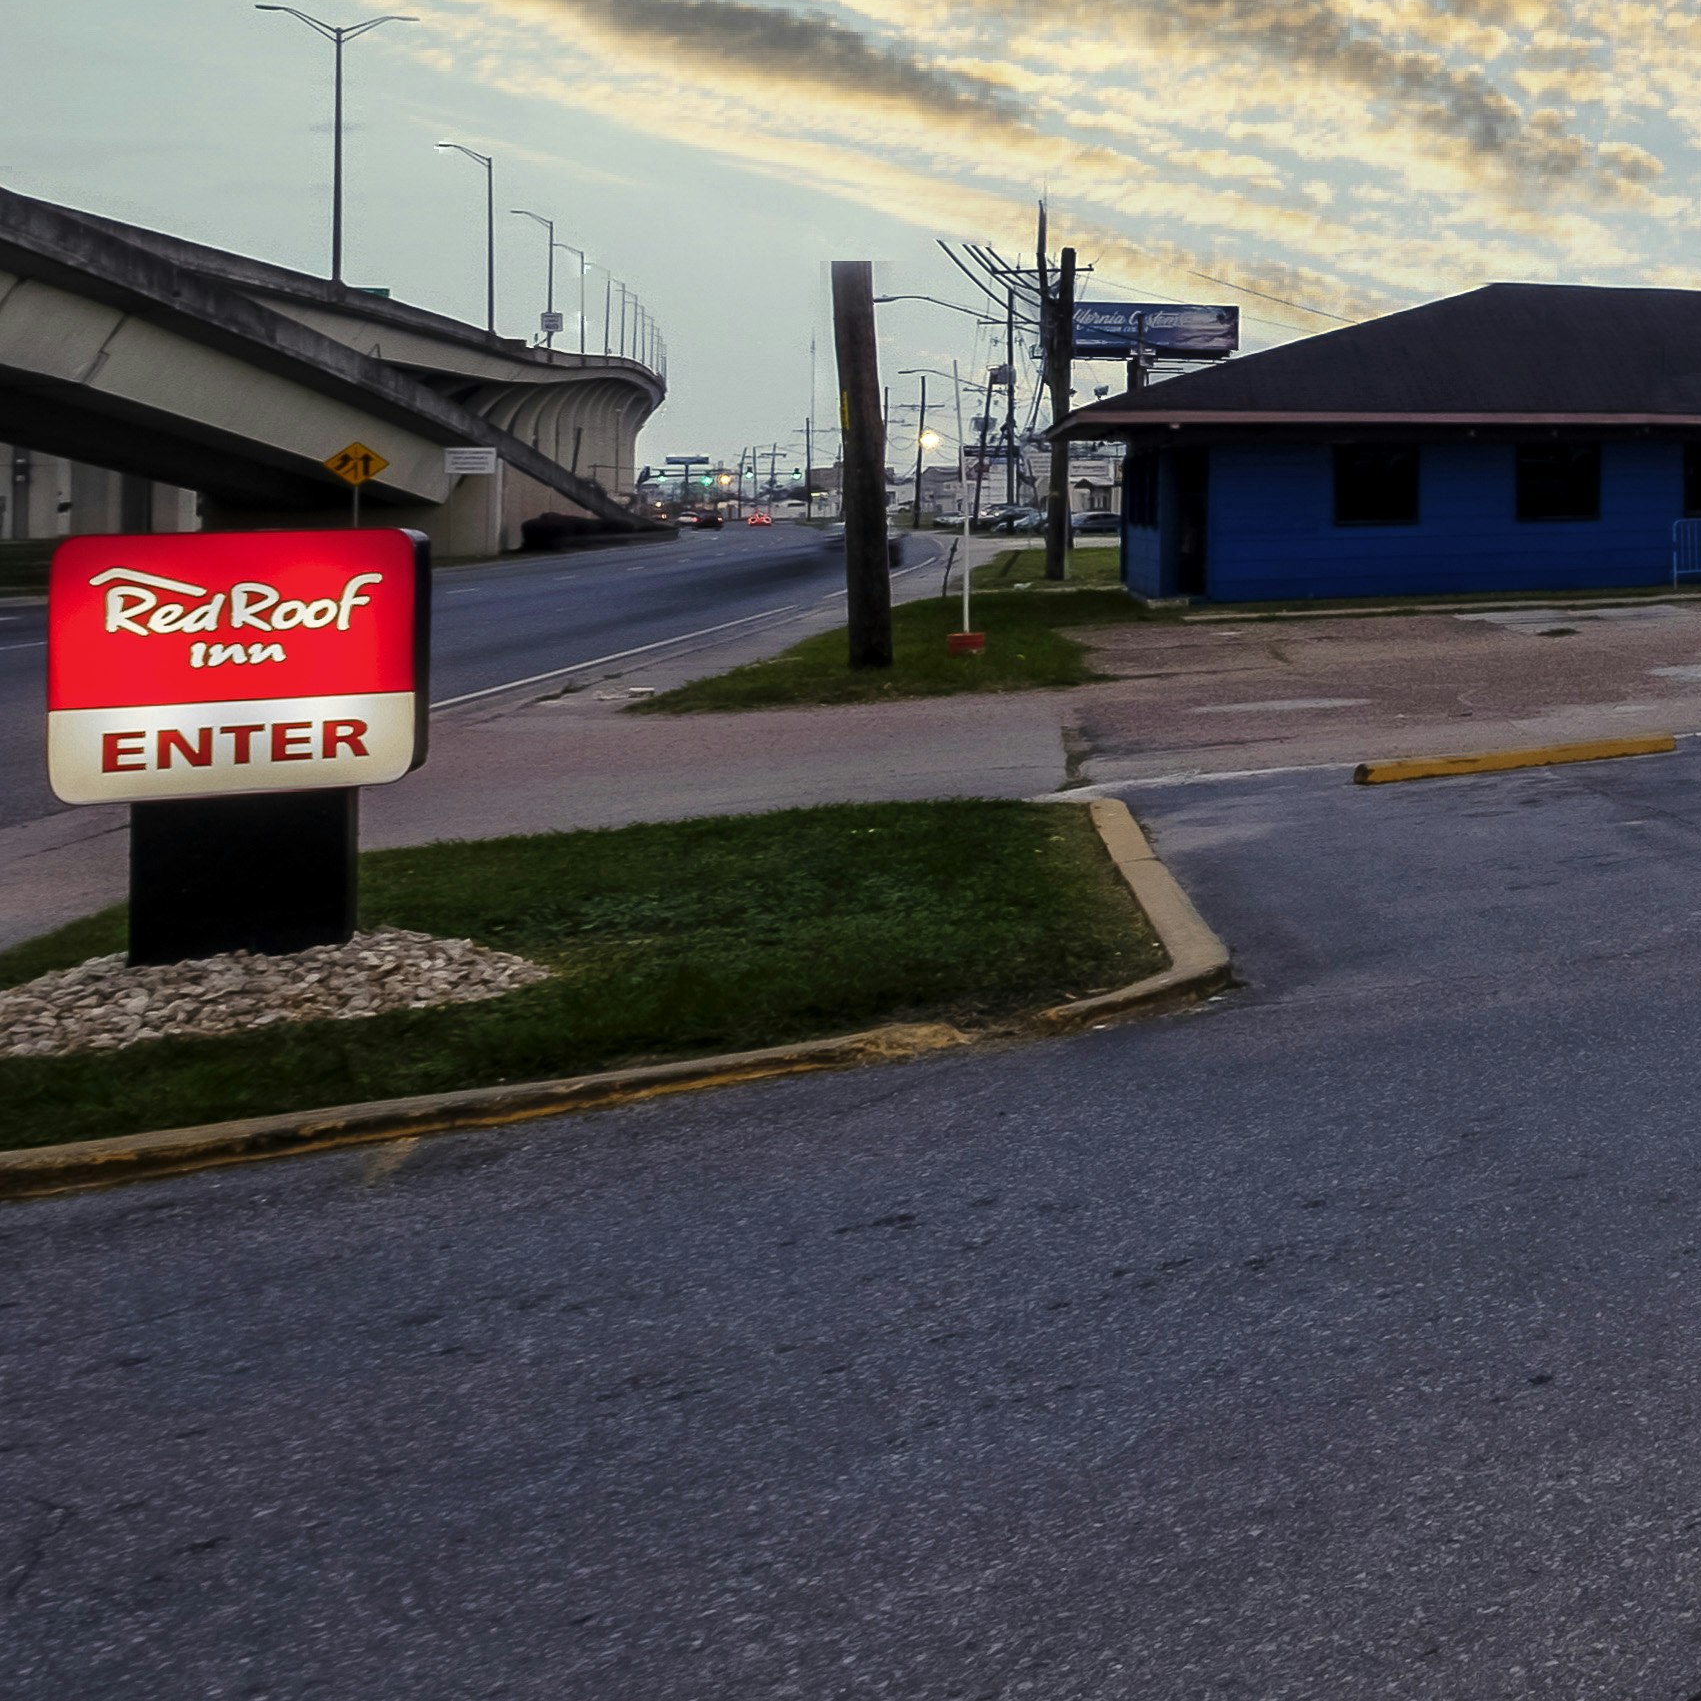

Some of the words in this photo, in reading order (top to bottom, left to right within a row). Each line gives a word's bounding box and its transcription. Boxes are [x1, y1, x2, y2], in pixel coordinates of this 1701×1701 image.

[104, 584, 225, 637] Red
[230, 571, 384, 632] Roof
[101, 718, 371, 774] ENTER
